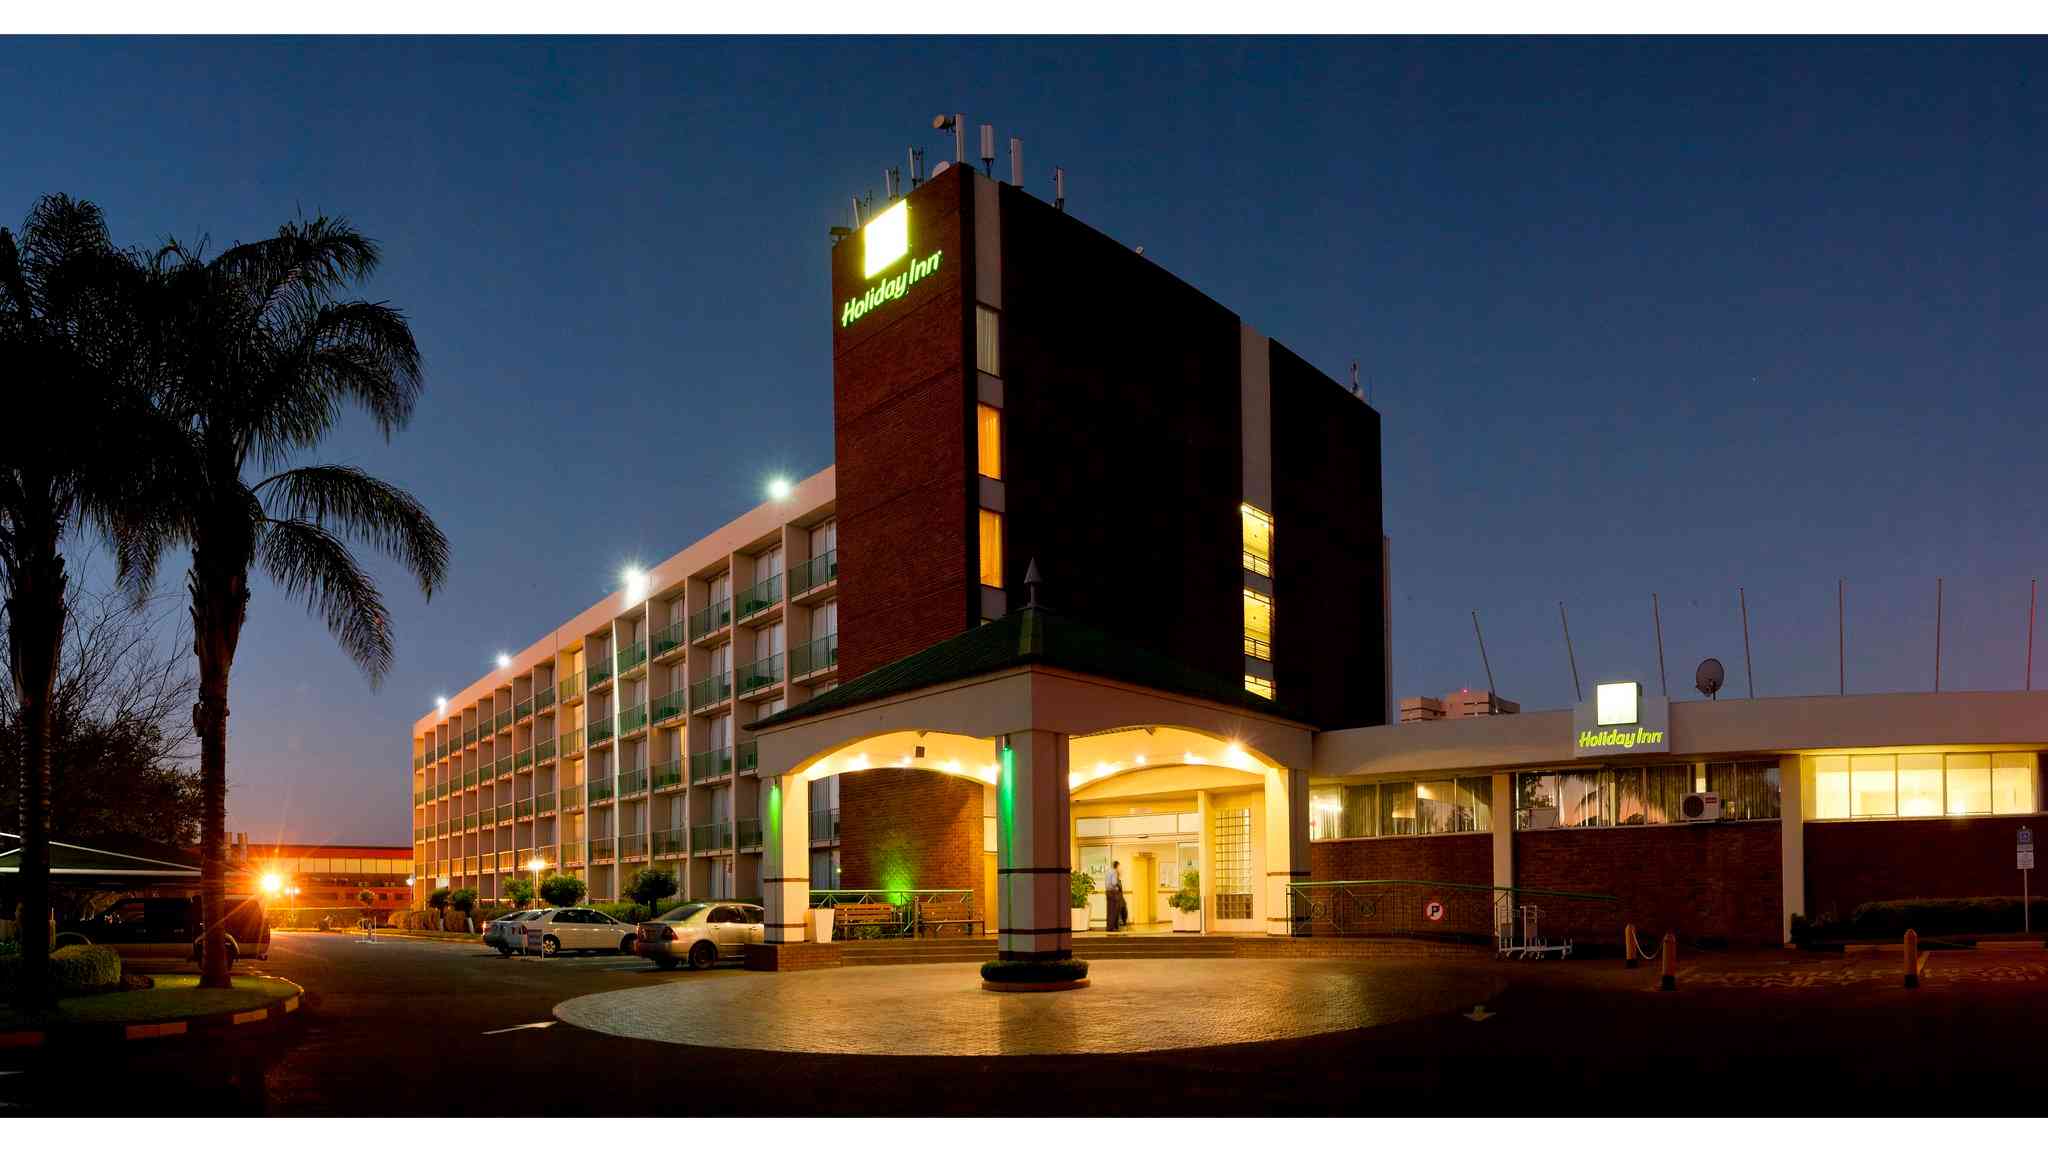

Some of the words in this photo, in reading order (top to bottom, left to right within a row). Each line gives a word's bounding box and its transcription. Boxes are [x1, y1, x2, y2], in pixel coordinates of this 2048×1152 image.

[841, 271, 907, 327] Holiday
[908, 253, 939, 285] Inn
[1579, 729, 1636, 748] Holiday
[1636, 727, 1663, 744] Inn
[1431, 905, 1441, 917] P
